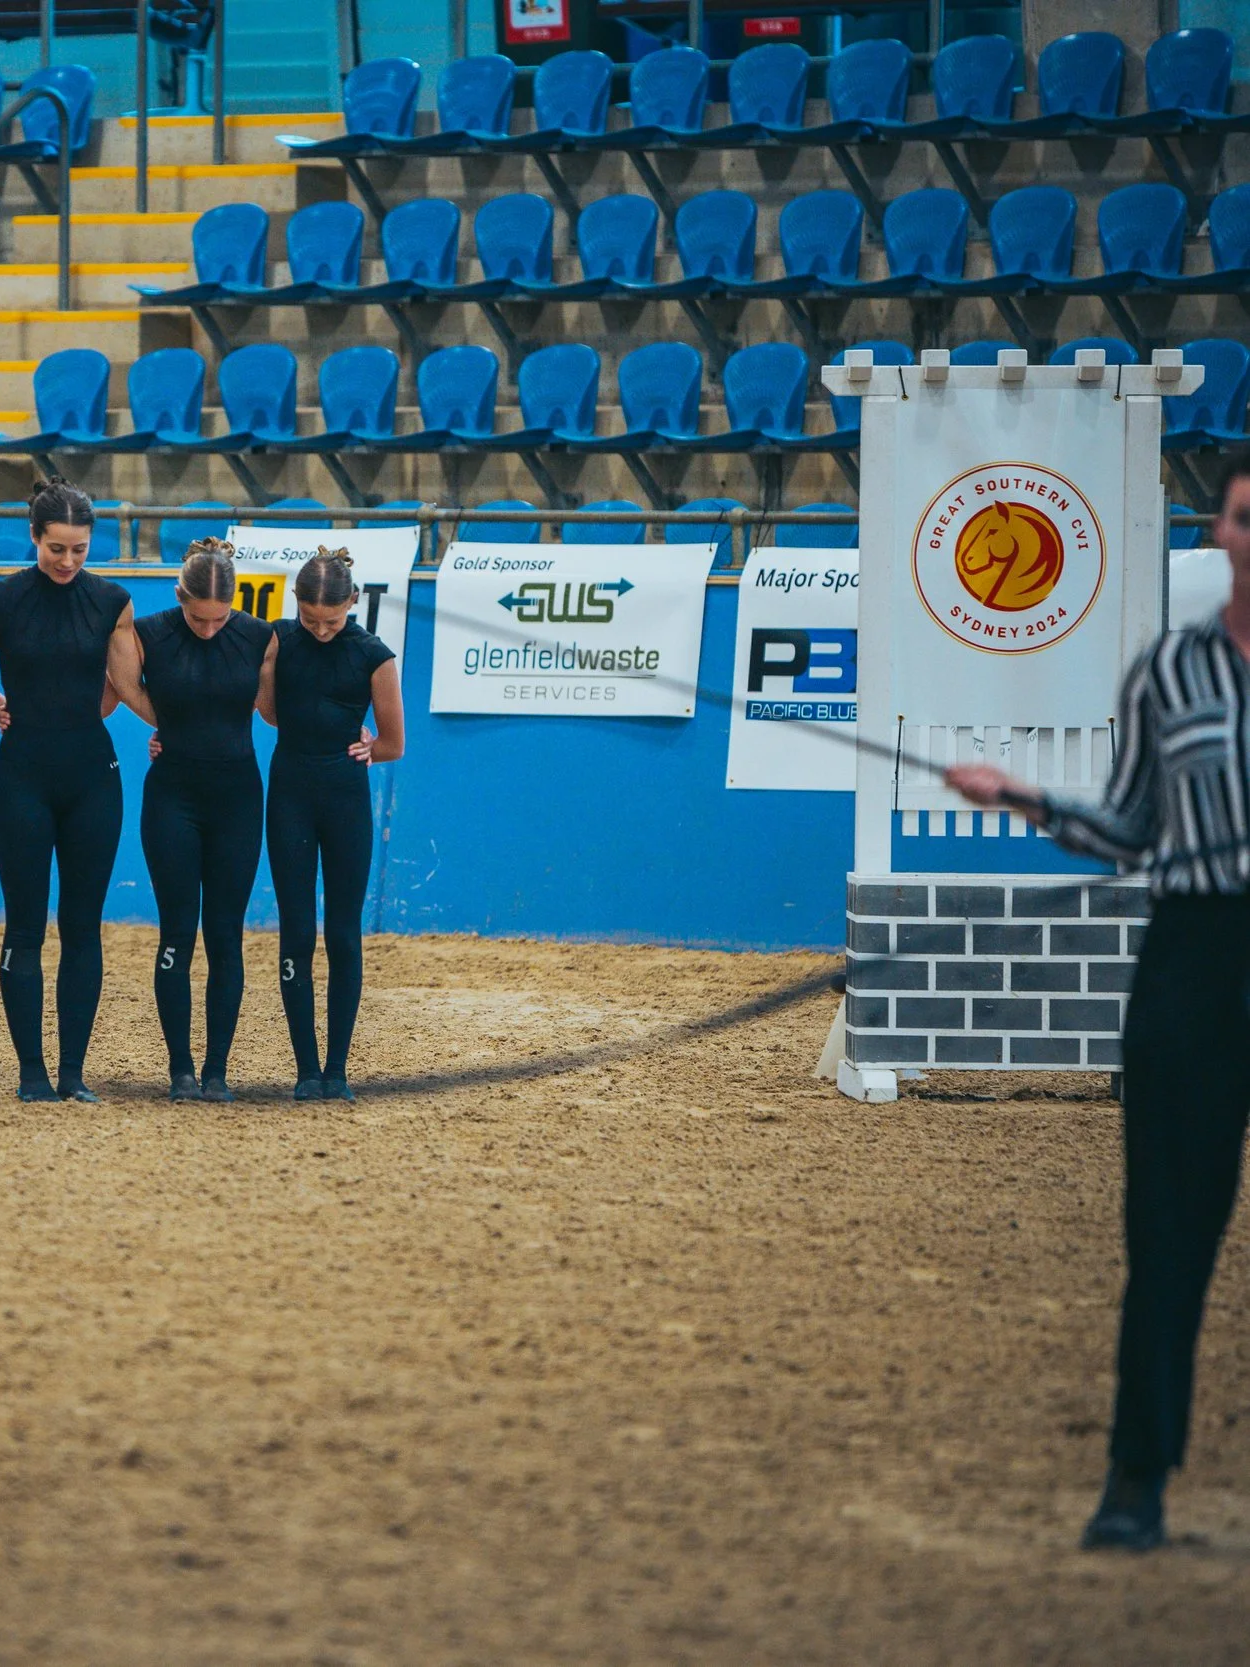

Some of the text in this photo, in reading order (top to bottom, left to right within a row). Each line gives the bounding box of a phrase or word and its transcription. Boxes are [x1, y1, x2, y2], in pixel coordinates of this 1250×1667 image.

[929, 478, 1089, 550] GREAT SOUTHERN CVI
[235, 546, 324, 563] Silver Spon
[453, 556, 555, 573] Gold Sponsor
[755, 568, 859, 593] Major Spo
[516, 582, 614, 623] GWS
[950, 605, 1067, 638] SYDNEY 2024
[464, 641, 660, 675] glenfieldwaste
[503, 685, 617, 700] SERVICES
[750, 702, 813, 719] PACIFIC
[1, 948, 13, 971] 1
[160, 946, 176, 970] 5
[281, 958, 296, 981] 3
